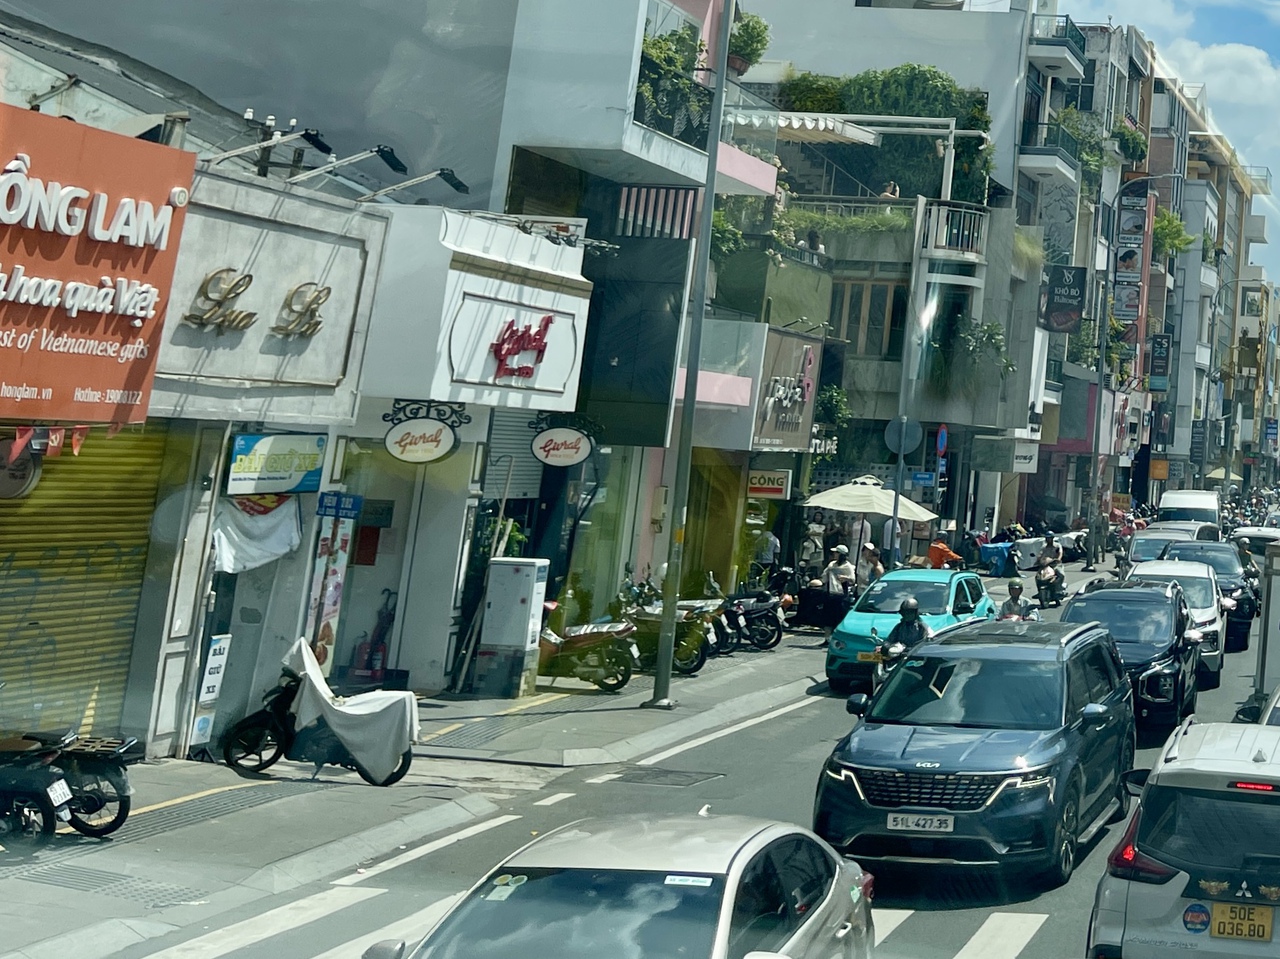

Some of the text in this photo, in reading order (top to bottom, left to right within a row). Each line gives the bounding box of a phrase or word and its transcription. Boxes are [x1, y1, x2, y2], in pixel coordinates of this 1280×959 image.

[88, 192, 173, 251] LAM
[8, 265, 62, 308] hoa
[61, 276, 114, 318] quà
[114, 277, 161, 328] Việt
[17, 328, 38, 354] of
[40, 327, 118, 358] Vietnamese
[117, 337, 150, 364] gifts
[394, 427, 443, 455] Givral
[539, 437, 582, 459] Givral
[294, 453, 319, 473] XE
[205, 684, 217, 695] XE
[1229, 906, 1255, 922] 50E
[1217, 921, 1265, 939] 036.80
